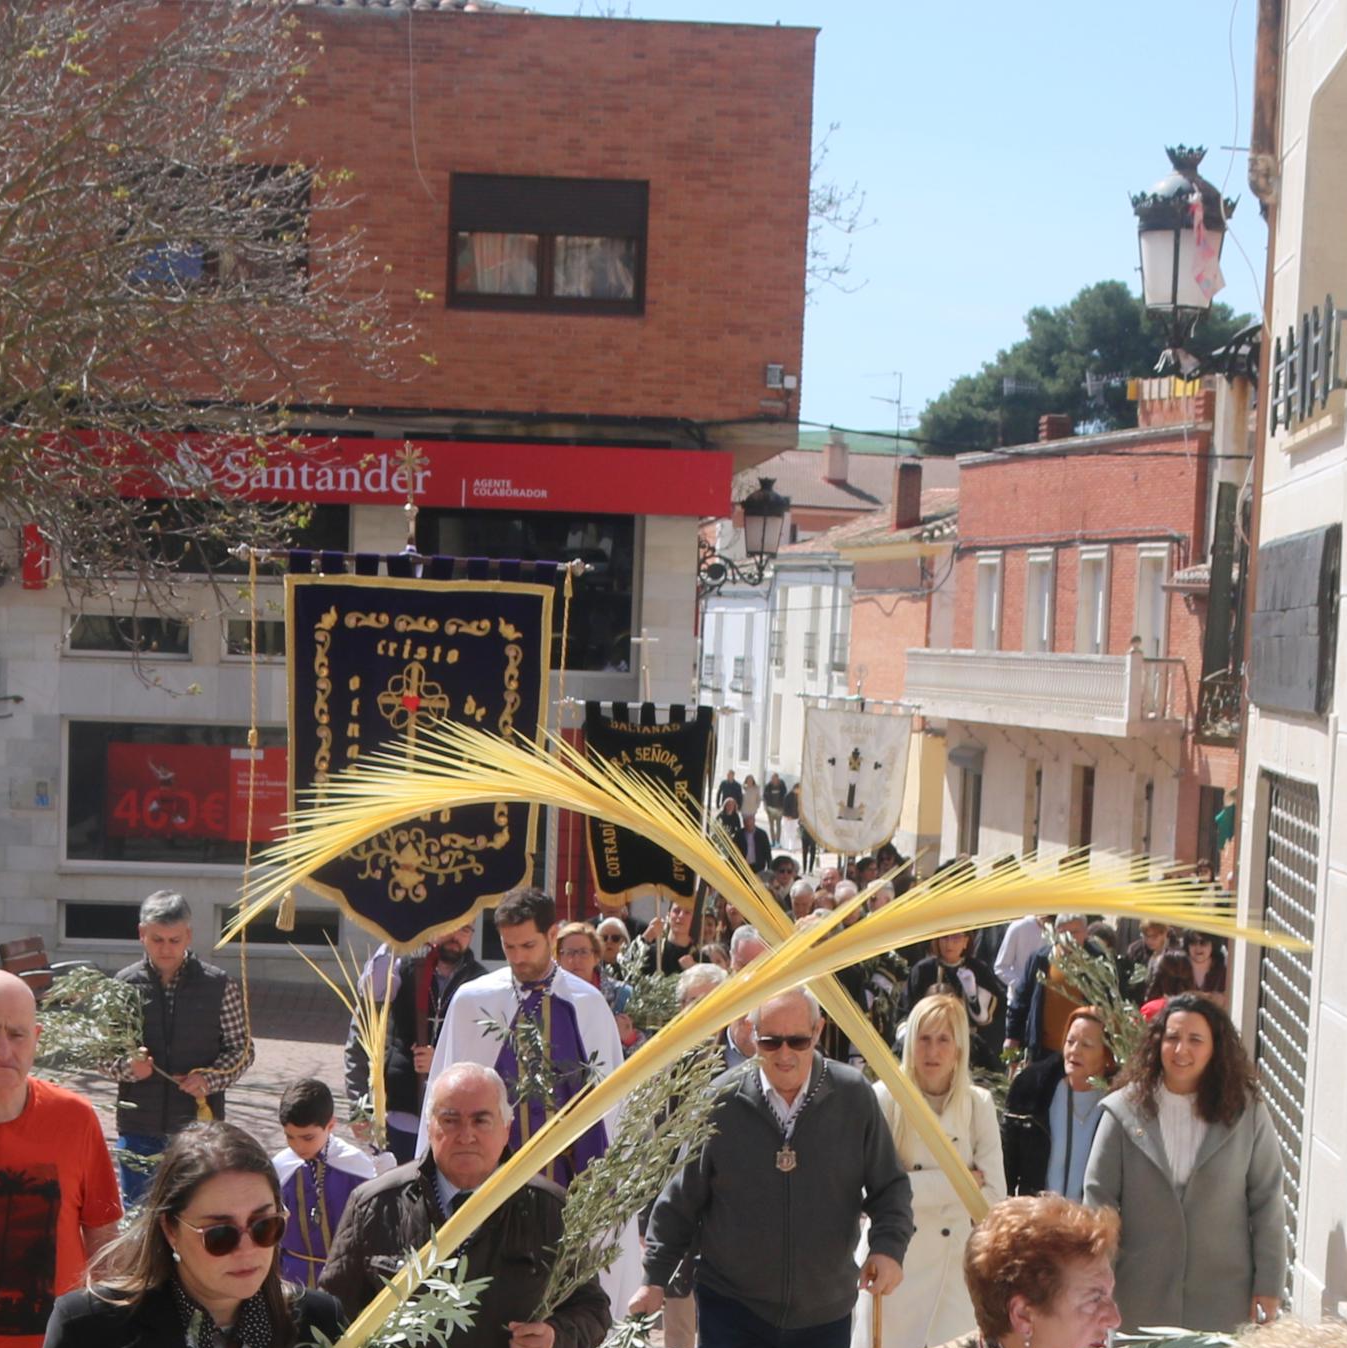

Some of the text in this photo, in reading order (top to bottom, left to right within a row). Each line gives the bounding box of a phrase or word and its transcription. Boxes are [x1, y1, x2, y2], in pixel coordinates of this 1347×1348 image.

[222, 451, 432, 496] Santander
[472, 478, 512, 489] AGENTE
[472, 487, 548, 498] COLABORADOR
[634, 743, 684, 777] SEÑORA
[598, 823, 621, 877] COFRADÍ
